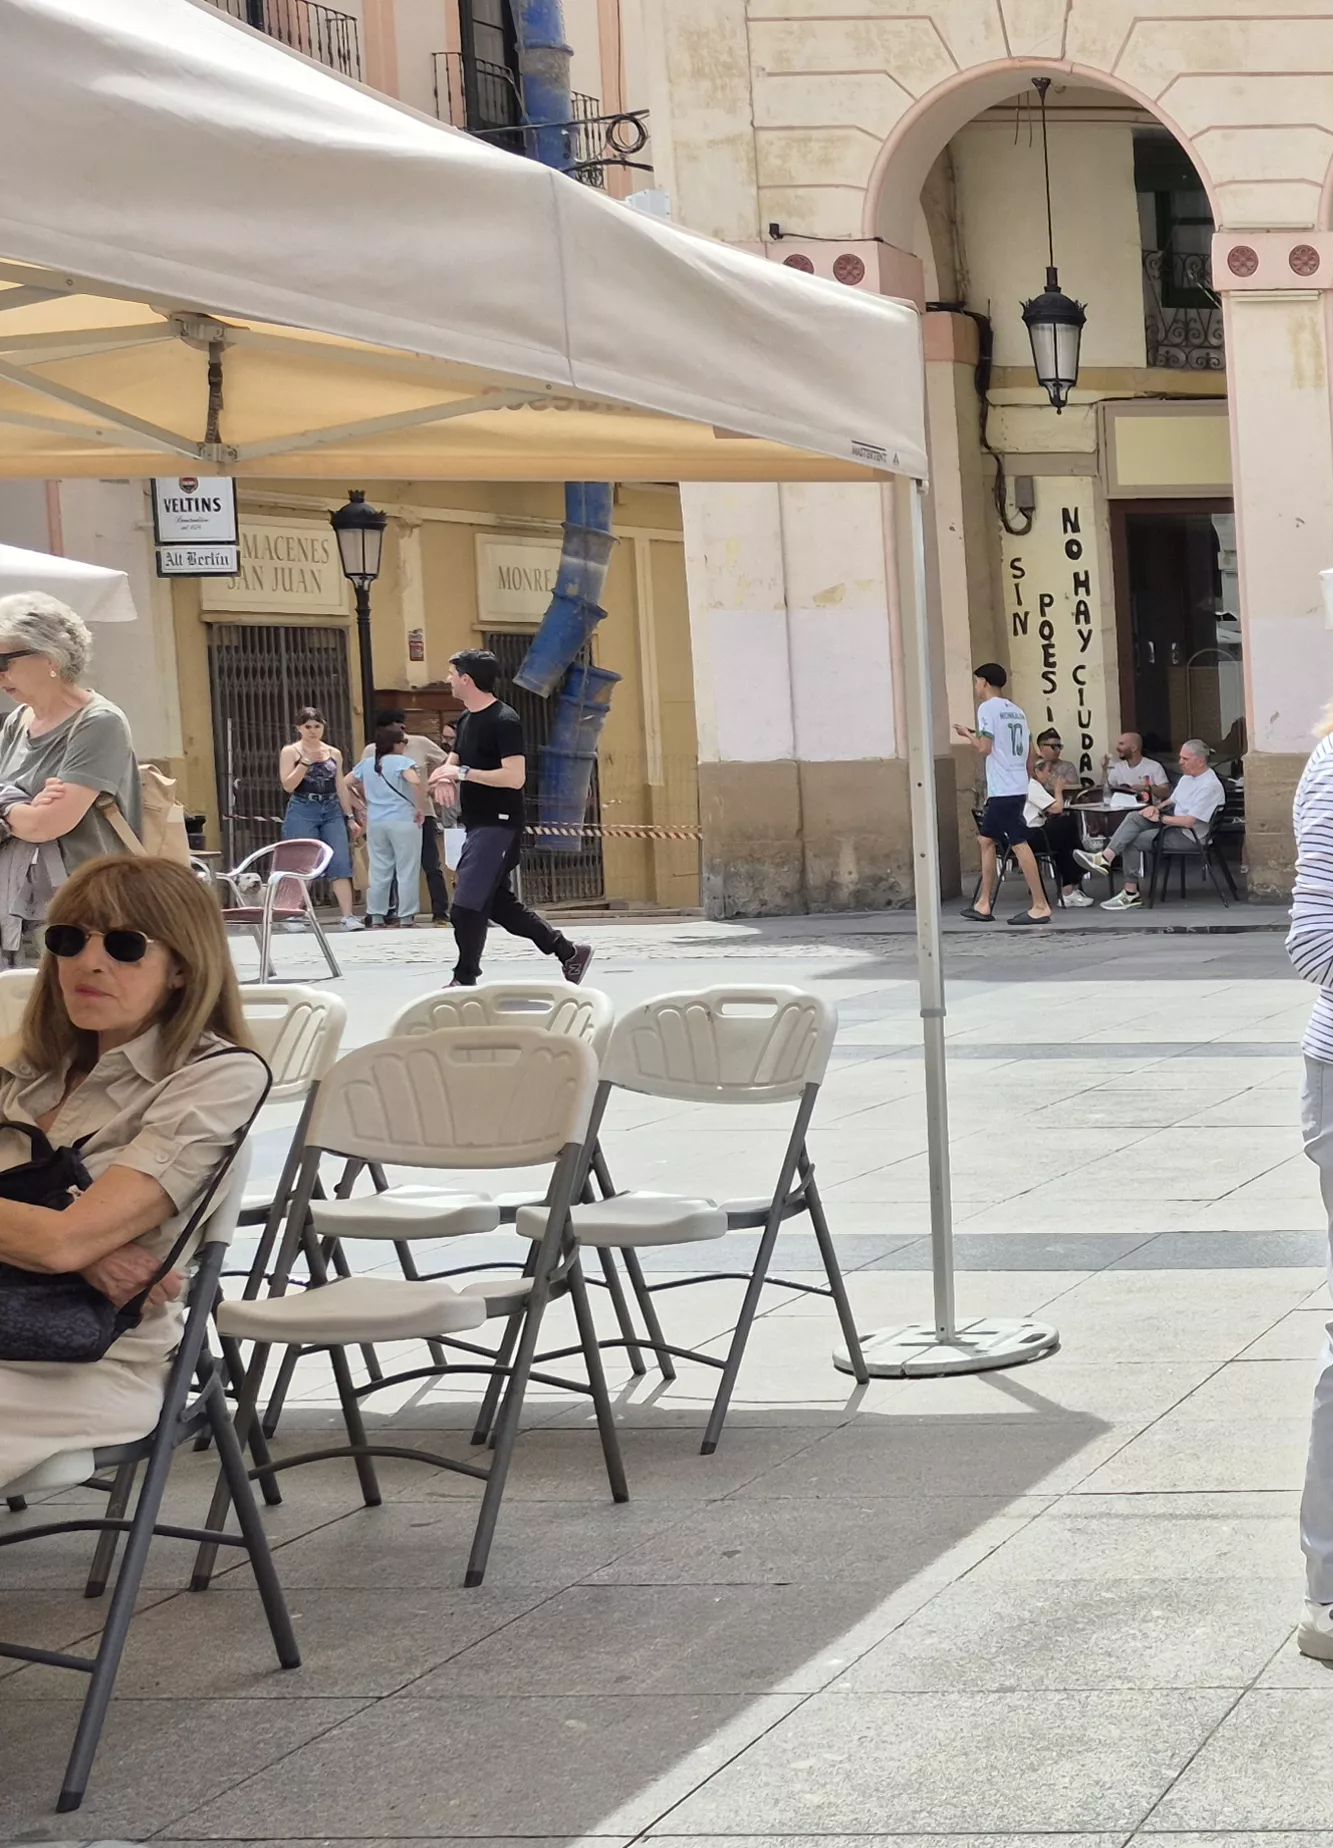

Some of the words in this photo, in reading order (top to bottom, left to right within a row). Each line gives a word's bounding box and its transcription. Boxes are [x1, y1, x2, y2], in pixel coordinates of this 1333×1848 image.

[164, 497, 222, 513] VELTINS
[165, 552, 184, 567] Alt
[187, 551, 230, 567] Berlin
[242, 532, 330, 564] MACENES
[271, 566, 323, 594] JUAN
[498, 565, 556, 592] MONRE
[1062, 506, 1083, 561] NO
[1073, 570, 1092, 653] HAY
[1010, 557, 1030, 636] SIN
